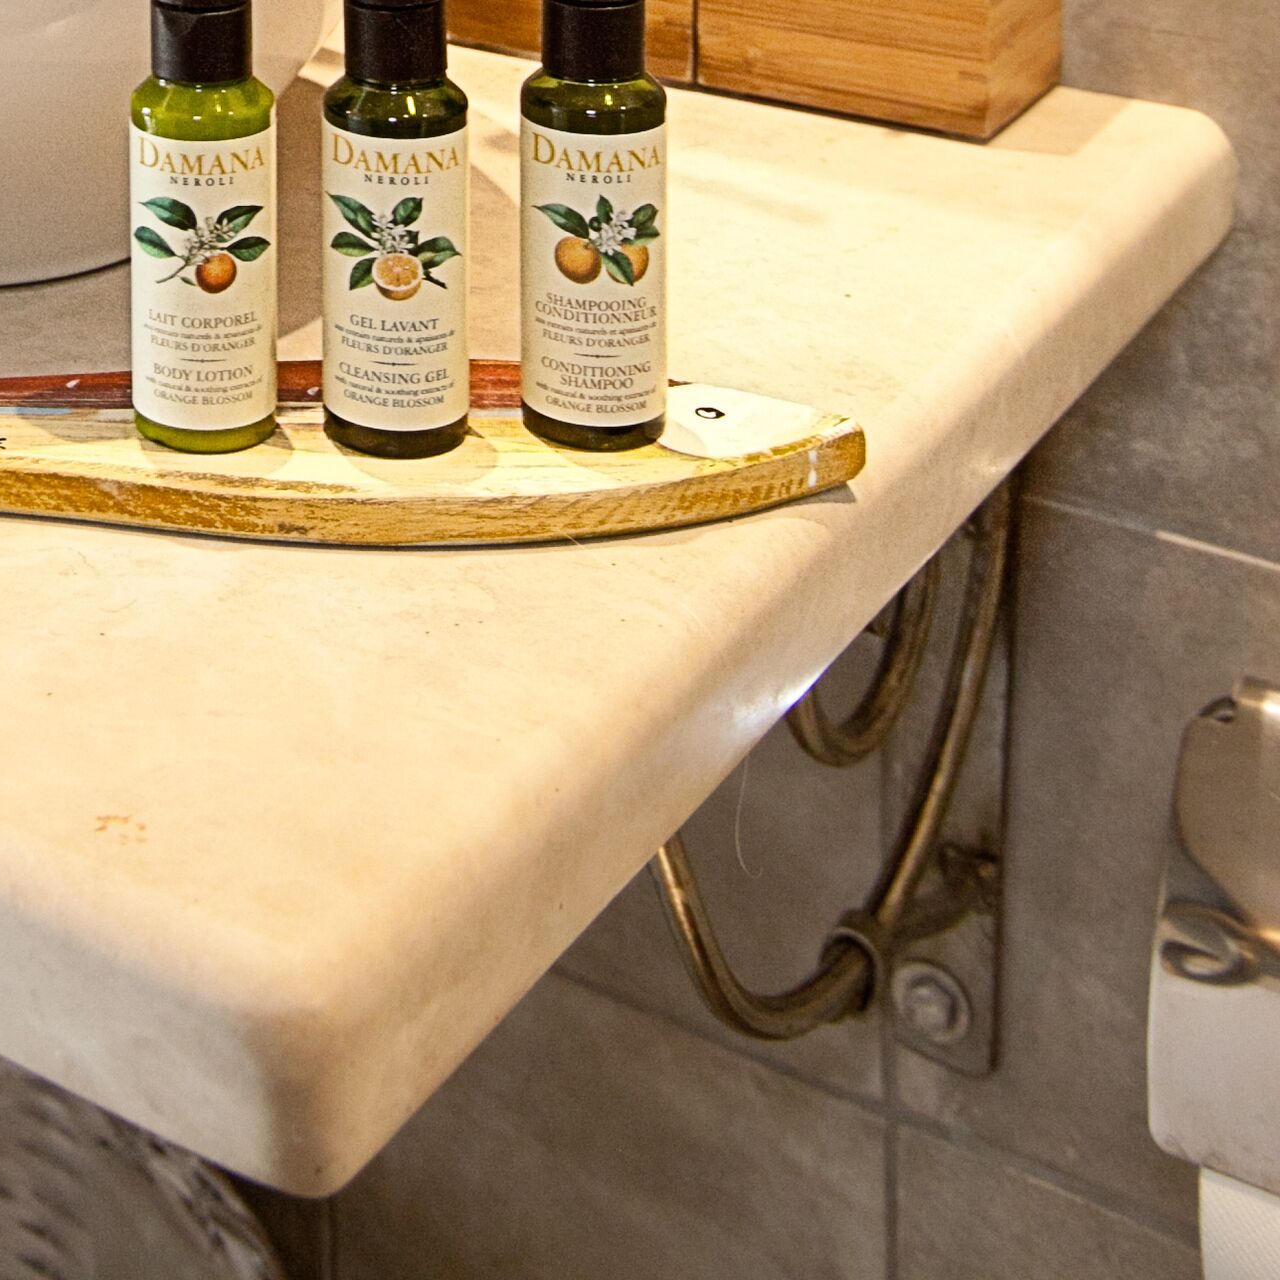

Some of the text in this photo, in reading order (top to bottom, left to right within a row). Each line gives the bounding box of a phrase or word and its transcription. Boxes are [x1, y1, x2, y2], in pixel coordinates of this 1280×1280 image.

[138, 136, 268, 177] DAMANA
[331, 132, 461, 175] DAMANA
[531, 131, 662, 173] DAMANA
[169, 176, 235, 187] NEROLI
[364, 173, 431, 185] NEROLI
[565, 172, 632, 184] NEROLI
[546, 292, 647, 311] SHAMPOOING
[149, 309, 258, 329] LAIT CORPOREL
[535, 300, 657, 324] CONDITIONNEUR
[350, 313, 440, 332] GEL LAVANT
[151, 334, 256, 352] FLEURS D'ORANGER
[341, 335, 448, 356] FLEURS D'ORANGER
[542, 328, 651, 348] FLEURS D'ORANGER
[153, 363, 254, 382] BODY LOTION
[338, 361, 449, 385] CLEANSING GEL
[541, 356, 651, 378] CONDITIONING
[560, 374, 634, 390] SHAMPOO
[153, 388, 253, 405] ORANGE BLOSSOM
[343, 388, 444, 408] ORANGE BLOSSOM
[545, 395, 648, 414] ORANGE BLOSSOM
